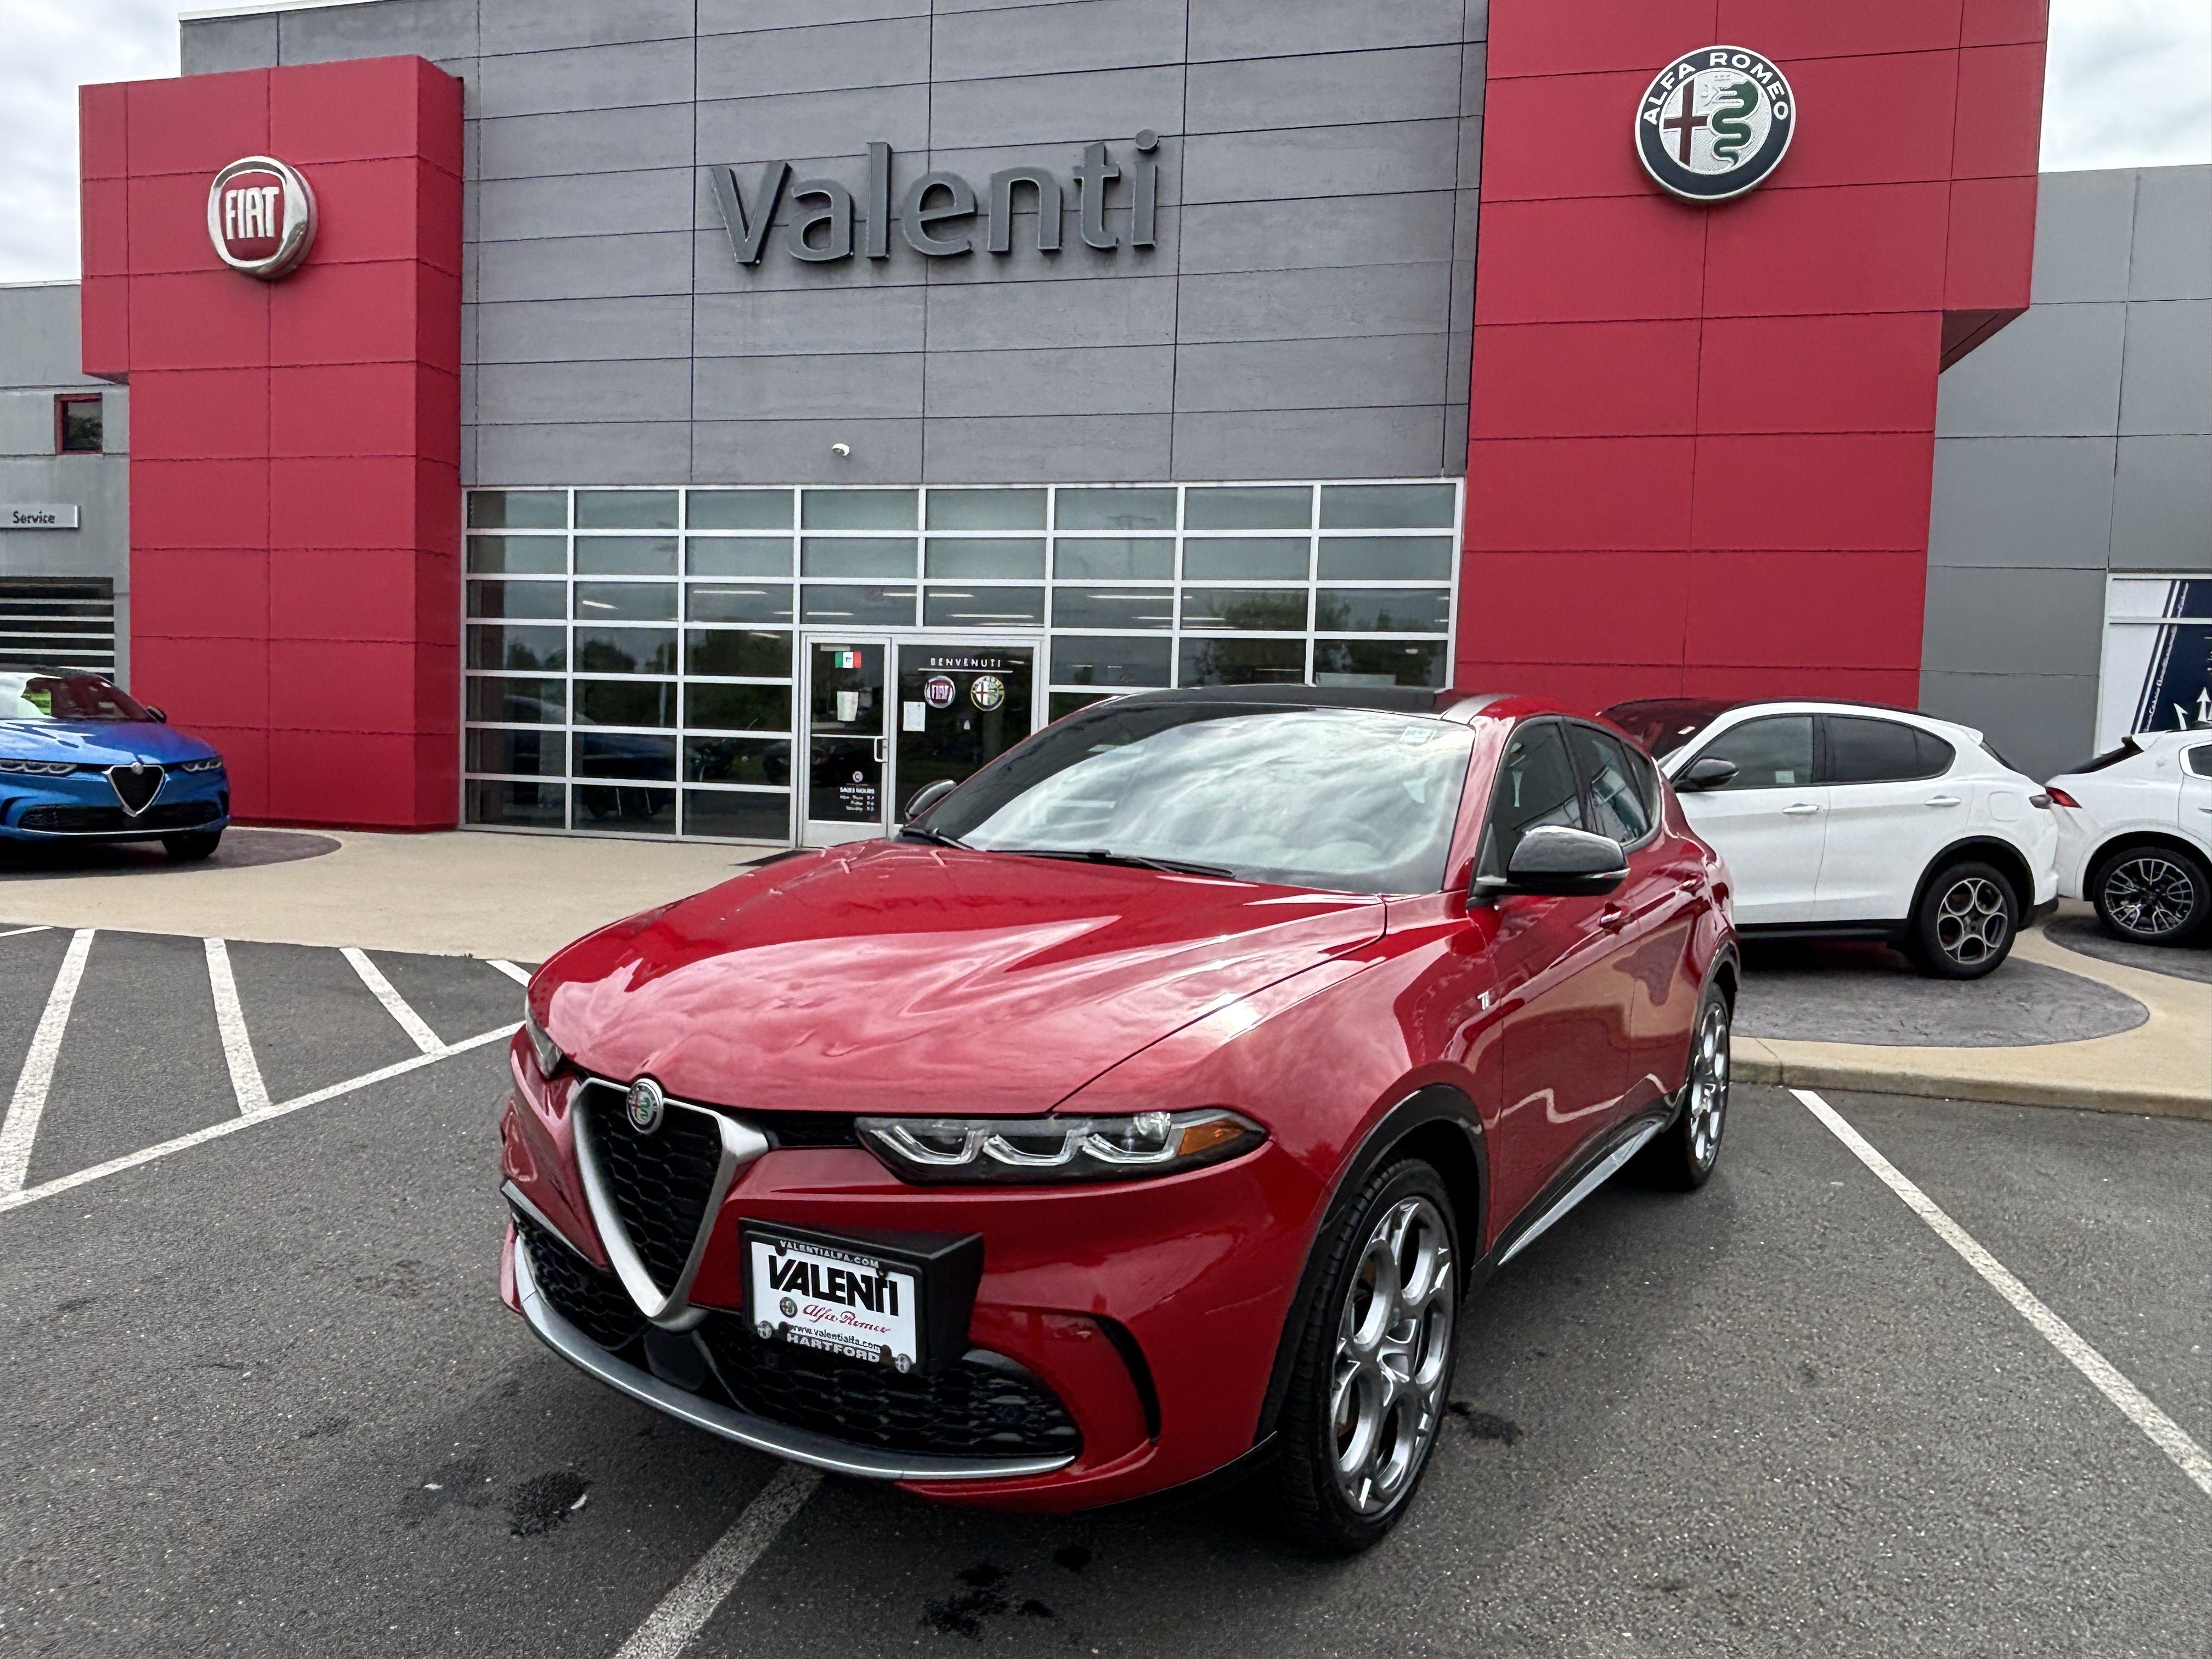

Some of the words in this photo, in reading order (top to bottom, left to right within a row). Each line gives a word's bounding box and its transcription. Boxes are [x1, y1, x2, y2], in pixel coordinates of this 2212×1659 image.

[1643, 63, 1696, 125] ALFA
[1709, 52, 1789, 120] ROMEO
[225, 186, 280, 240] FIAT
[712, 129, 1159, 266] Valenti
[13, 510, 55, 523] Service
[930, 657, 1001, 667] BENVENUTI
[768, 1254, 899, 1317] VALENTI
[803, 1304, 838, 1323] Alfa
[839, 1311, 891, 1333] Romeo
[787, 1333, 880, 1363] HARTFORD
